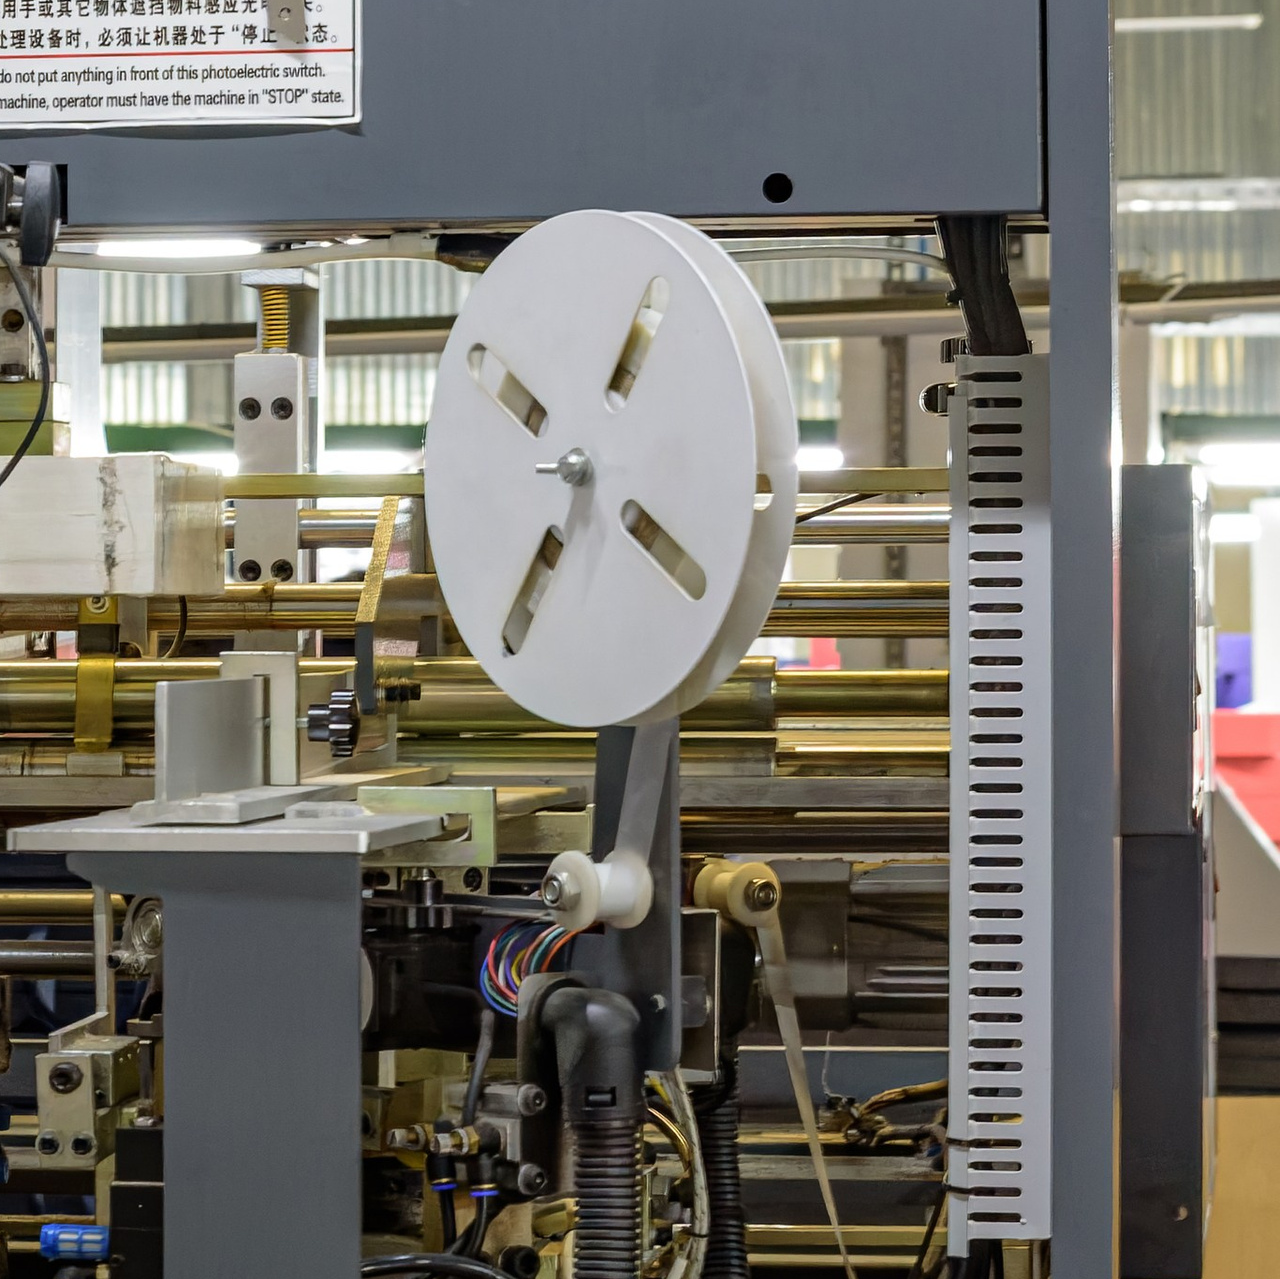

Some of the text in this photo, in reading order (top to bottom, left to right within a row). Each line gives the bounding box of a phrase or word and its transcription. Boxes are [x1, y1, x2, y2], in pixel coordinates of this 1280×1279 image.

[15, 69, 35, 83] not
[37, 69, 58, 86] put
[61, 67, 113, 86] anything
[116, 66, 127, 81] in
[130, 65, 159, 81] front
[162, 64, 175, 80] of
[177, 64, 198, 80] this
[201, 63, 280, 83] photoelectric
[283, 62, 326, 78] switch.
[52, 93, 103, 110] operator
[106, 92, 137, 107] must
[140, 91, 168, 106] have
[172, 90, 191, 105] the
[194, 89, 245, 106] machine
[248, 88, 259, 104] in
[262, 87, 308, 105] "STOP"
[311, 88, 344, 104] state.
